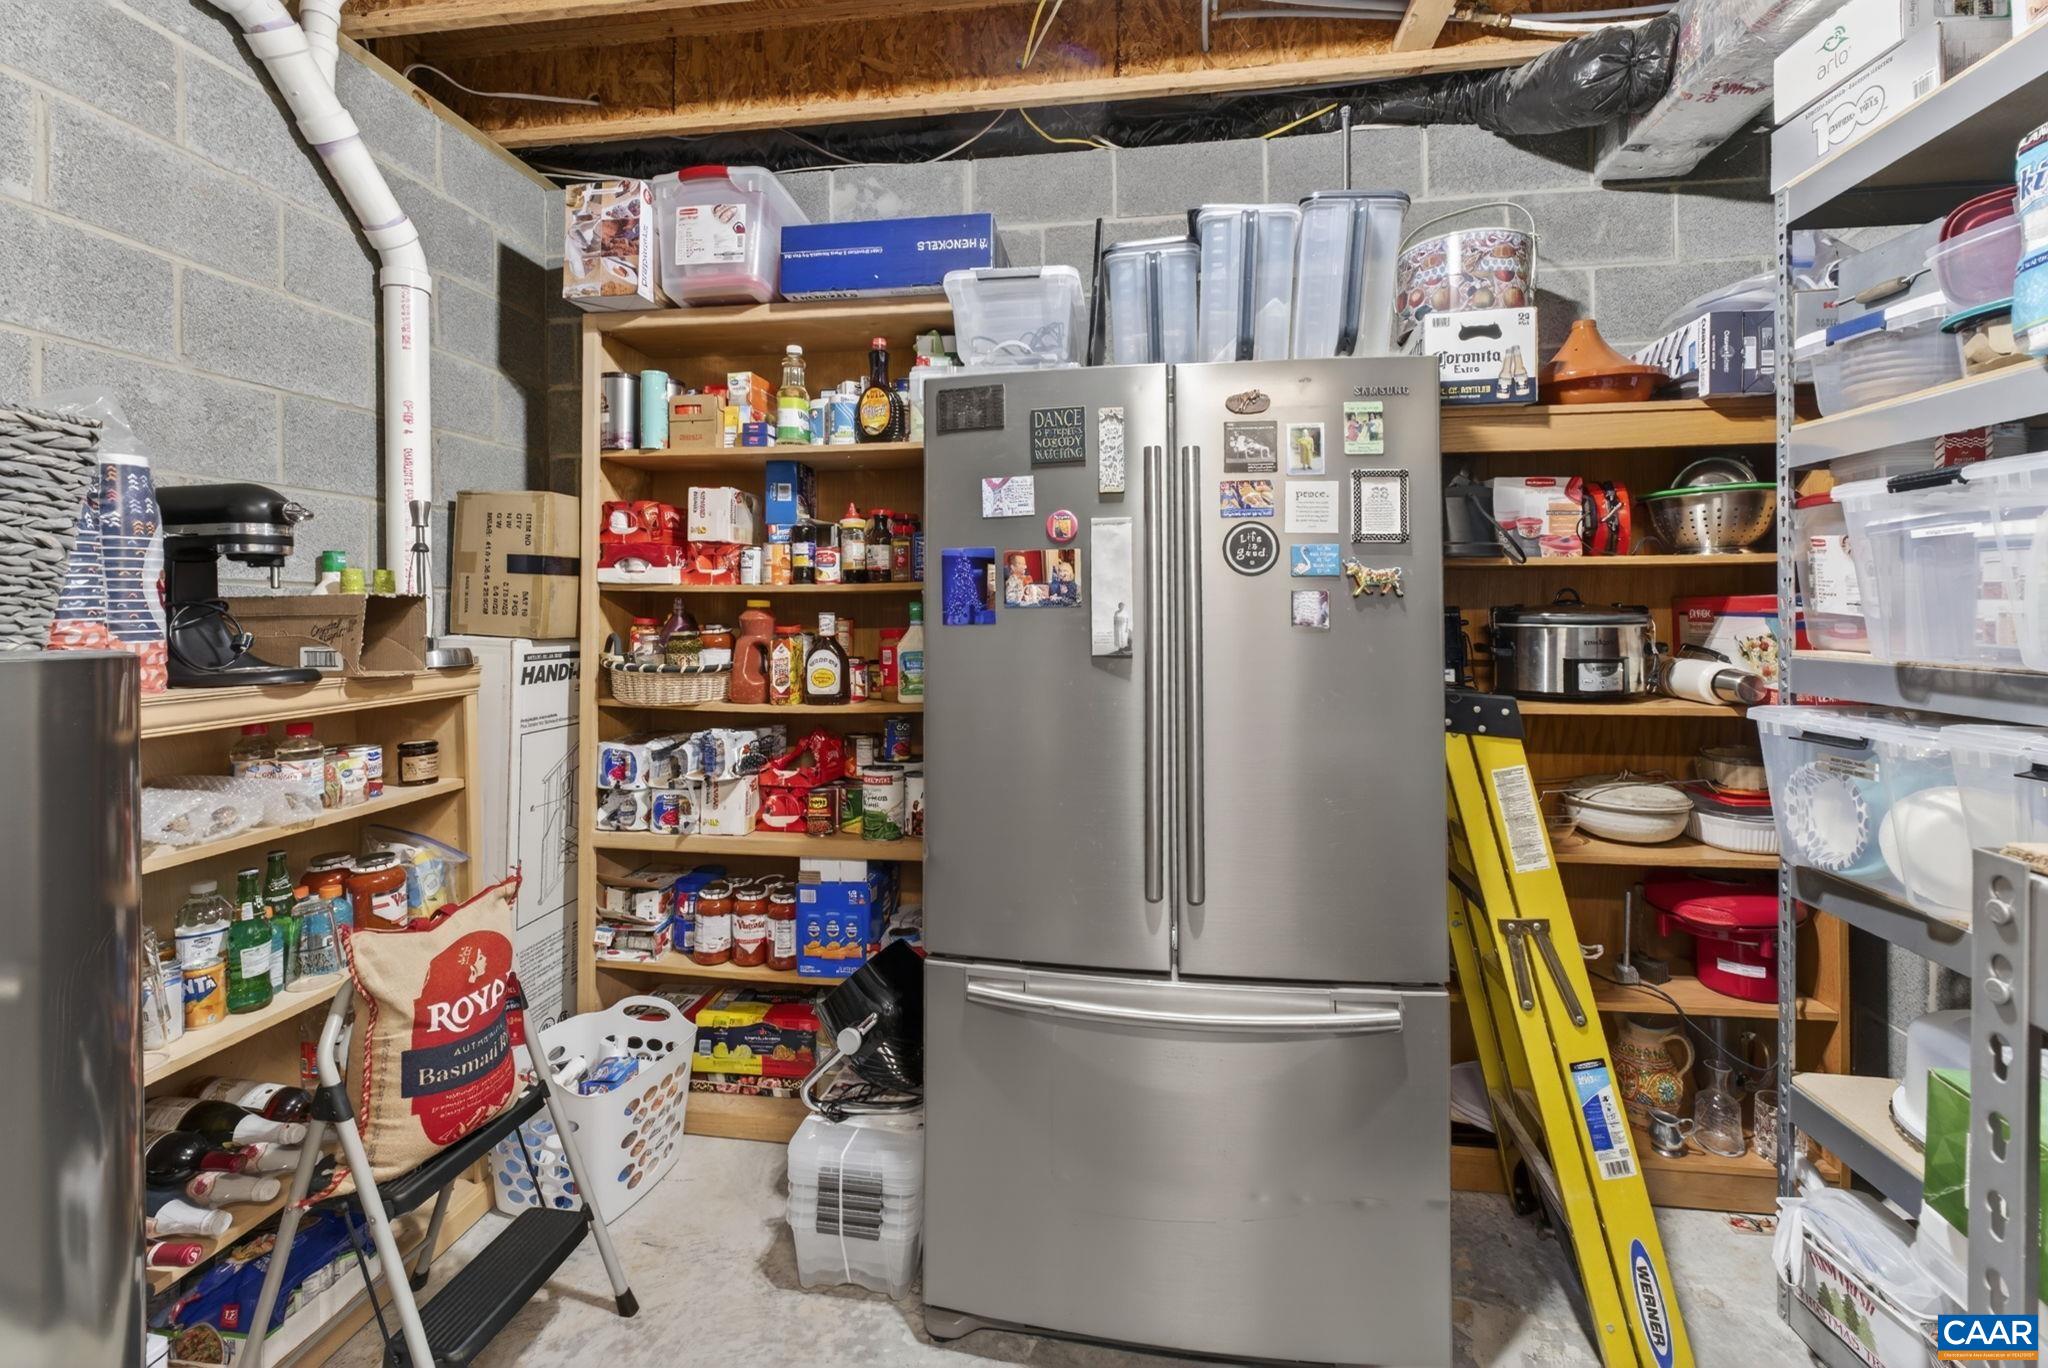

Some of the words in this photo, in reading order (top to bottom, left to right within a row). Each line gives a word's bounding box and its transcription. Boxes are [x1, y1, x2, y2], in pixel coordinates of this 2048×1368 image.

[1817, 49, 1849, 80] arlo
[1353, 385, 1410, 397] SAMSUNG
[1034, 408, 1082, 429] DANCE
[1033, 435, 1083, 448] NOBODY
[1240, 530, 1262, 544] Life
[1236, 547, 1268, 560] good.
[418, 1043, 499, 1087] Basmati
[1637, 1265, 1666, 1347] WERNER
